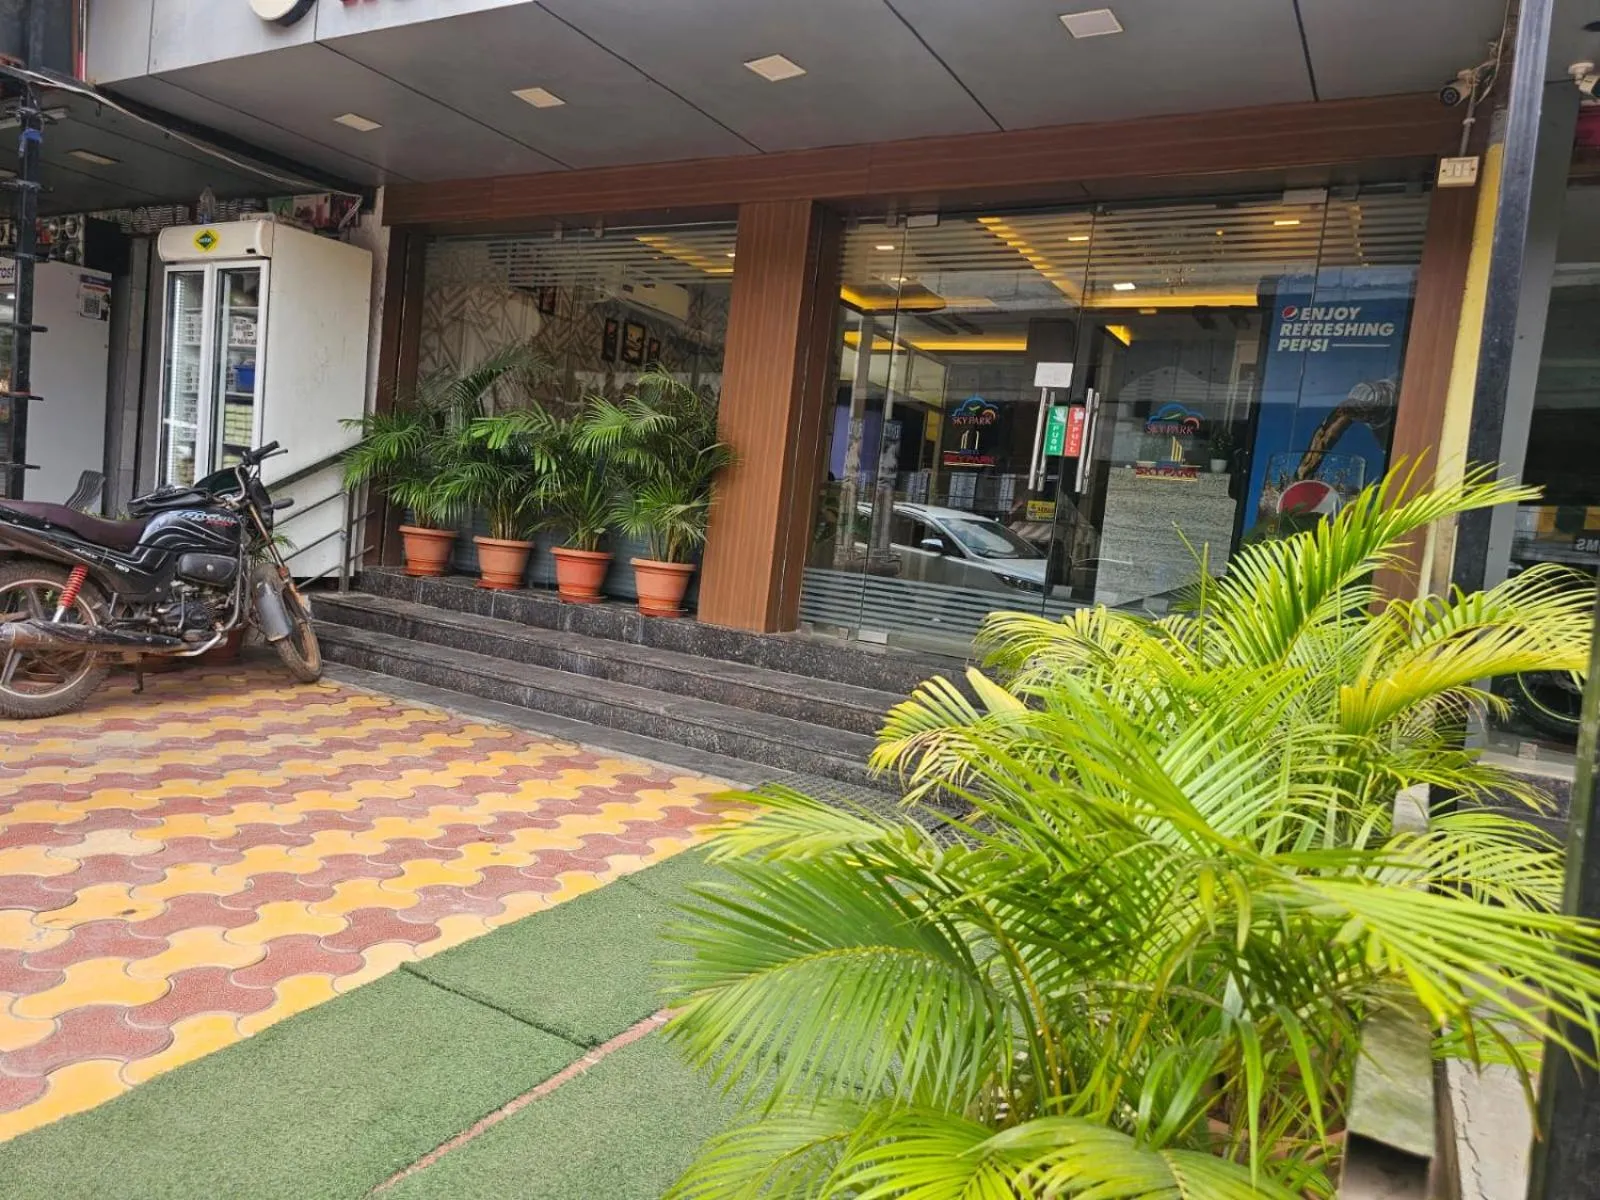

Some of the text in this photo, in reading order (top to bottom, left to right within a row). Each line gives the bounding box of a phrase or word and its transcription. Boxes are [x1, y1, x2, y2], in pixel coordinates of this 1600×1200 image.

[1300, 307, 1361, 320] ENJOY
[1280, 323, 1394, 336] REFRESHING
[1278, 338, 1329, 352] PEPSI
[1070, 427, 1079, 453] PULL
